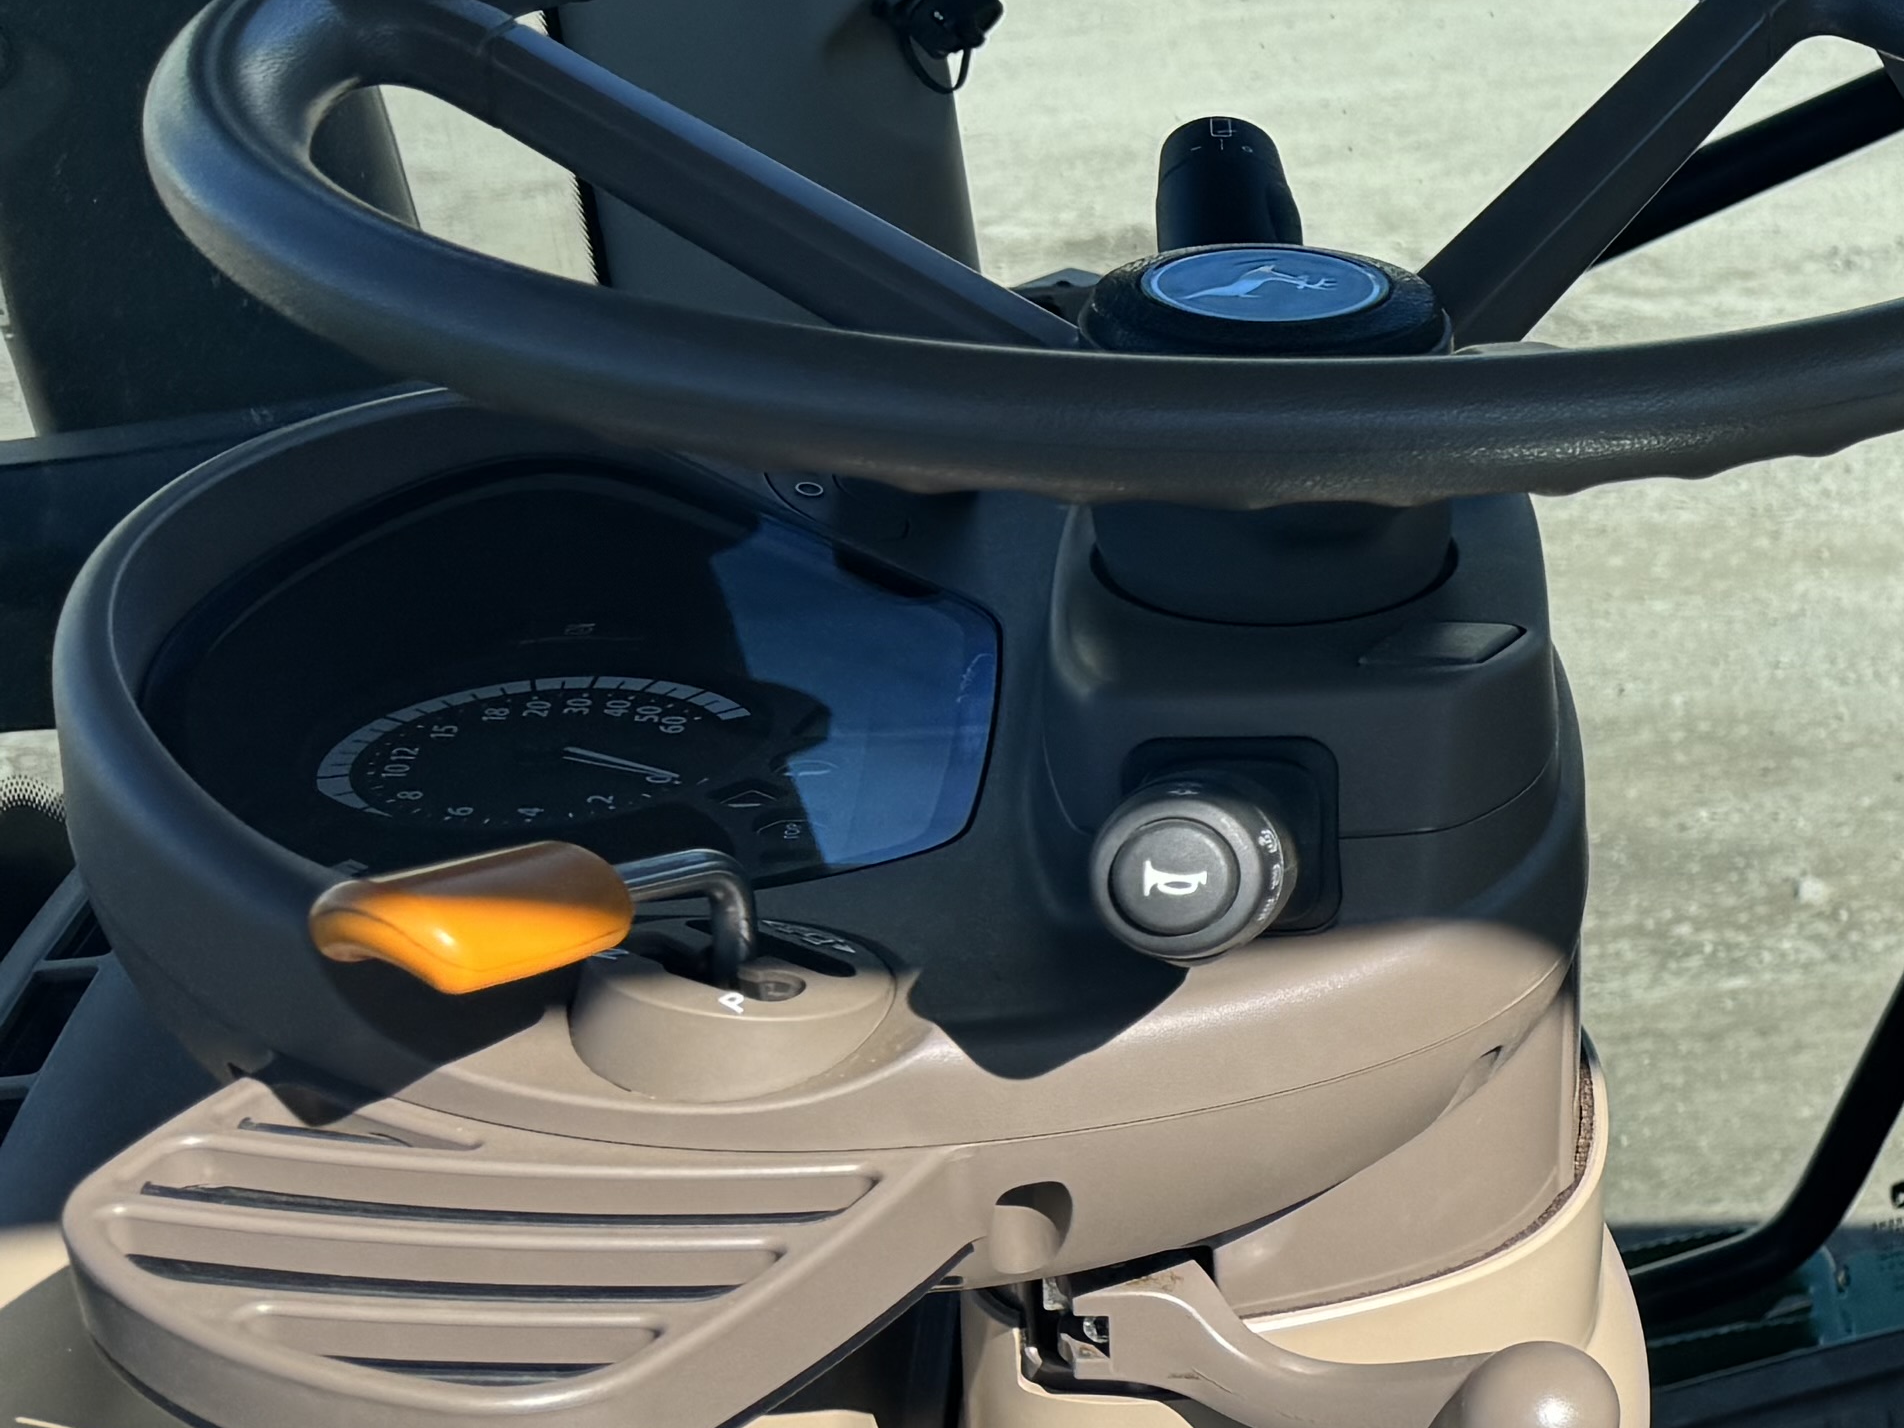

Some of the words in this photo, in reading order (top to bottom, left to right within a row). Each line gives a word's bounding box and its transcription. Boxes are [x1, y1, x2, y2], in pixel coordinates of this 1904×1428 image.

[481, 707, 511, 721] 18
[522, 700, 552, 718] 20
[563, 697, 592, 716] 30
[603, 699, 632, 717] 40
[633, 705, 663, 723] 50
[430, 724, 458, 738] 15
[659, 715, 687, 734] 60
[391, 746, 419, 761] 12
[381, 763, 411, 778] 10
[396, 789, 424, 801] 8
[587, 794, 614, 805] 2
[447, 806, 474, 817] 6
[517, 807, 545, 817] 4
[716, 991, 745, 1016] P
